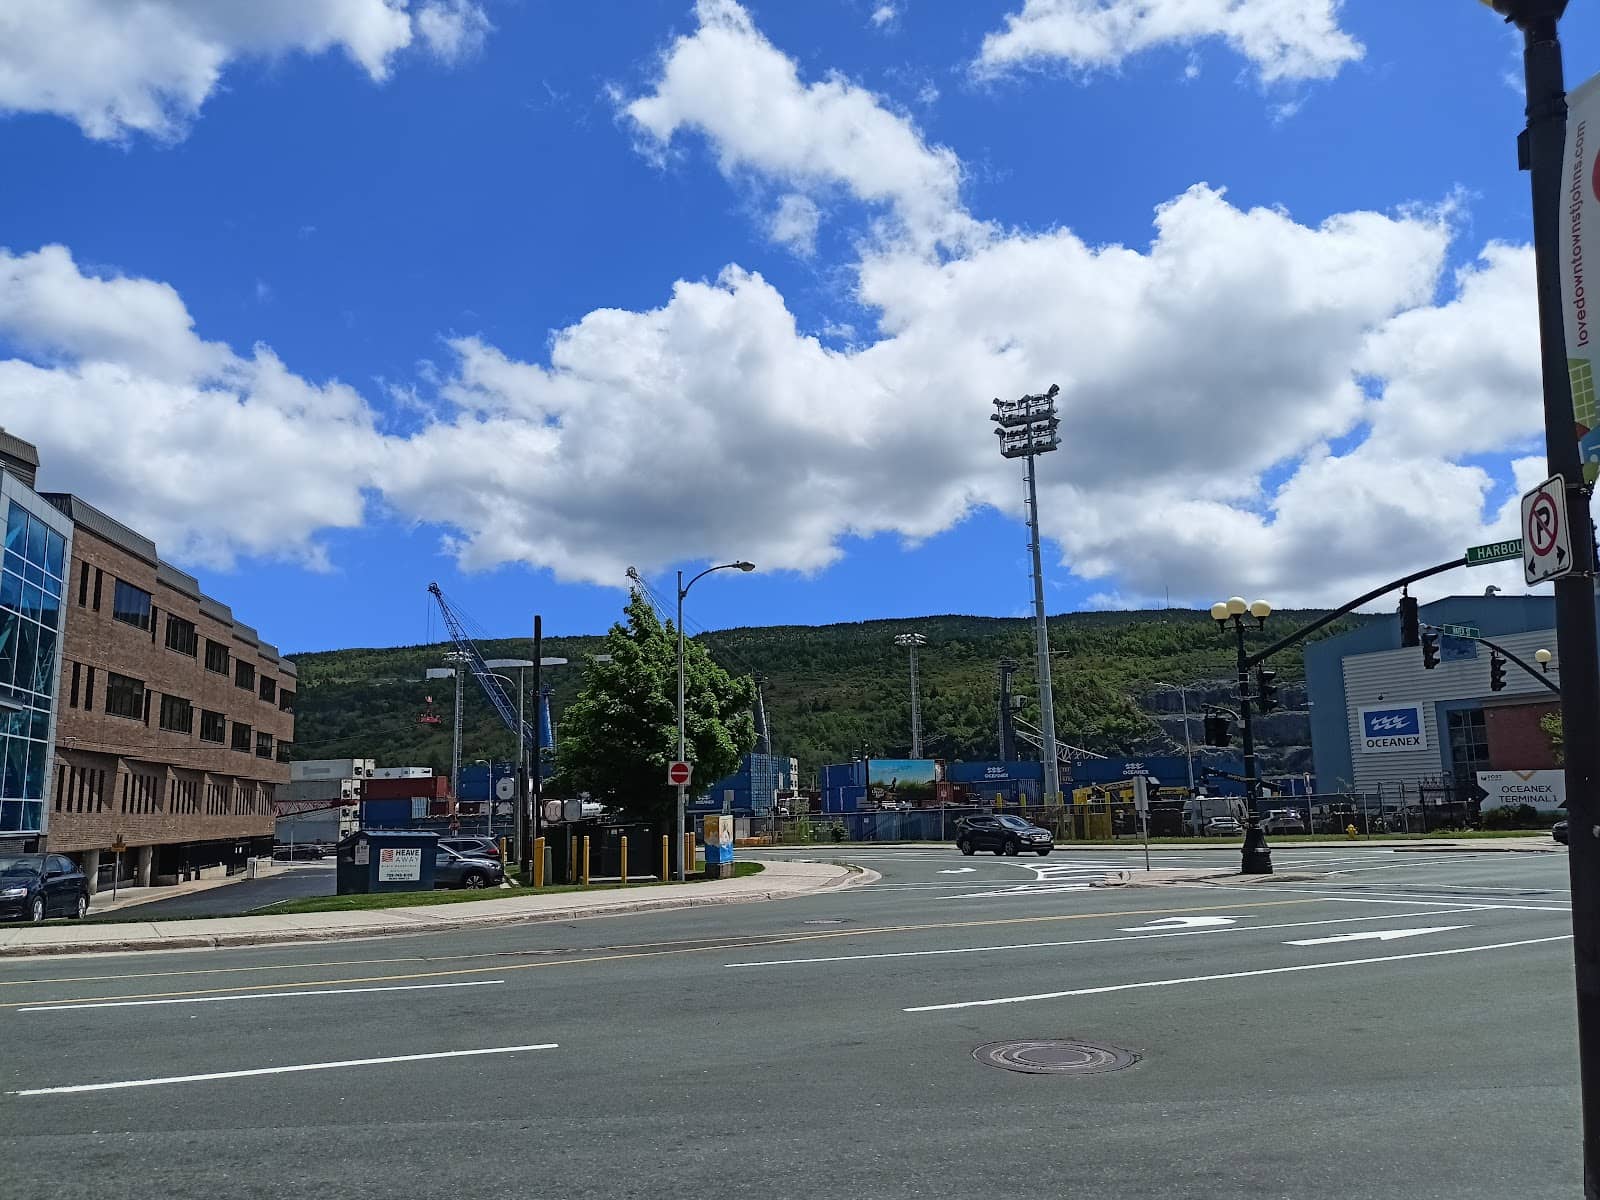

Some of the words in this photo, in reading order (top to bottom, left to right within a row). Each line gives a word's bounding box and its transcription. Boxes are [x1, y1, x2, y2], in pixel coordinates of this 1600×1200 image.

[1569, 120, 1589, 348] lovedowntownstjohns.com
[1366, 736, 1420, 748] OCEANEX
[1501, 785, 1553, 793] OCEANEX
[1498, 794, 1552, 803] TERMINAL
